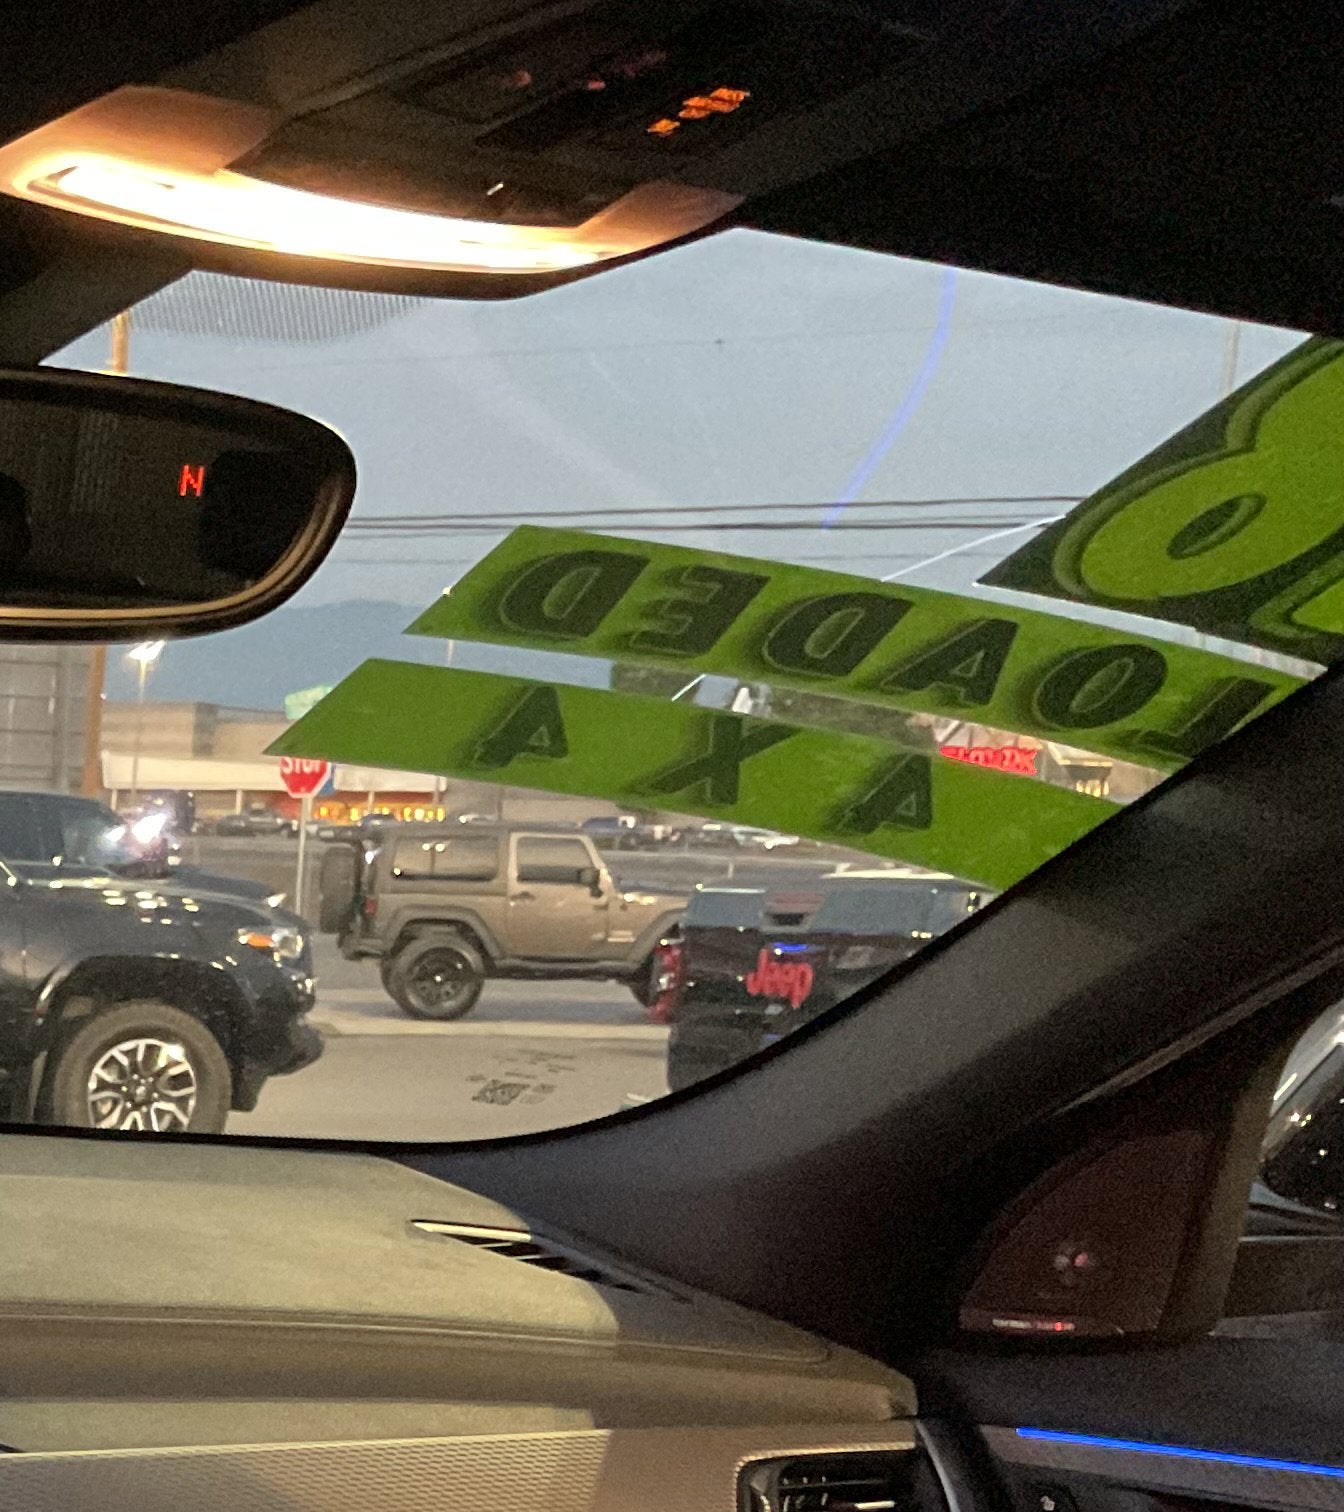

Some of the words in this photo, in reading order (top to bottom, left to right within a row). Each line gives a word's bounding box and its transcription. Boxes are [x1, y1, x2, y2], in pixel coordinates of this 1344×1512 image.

[178, 464, 205, 497] N
[280, 755, 321, 775] STOP
[745, 948, 815, 1010] Jeep
